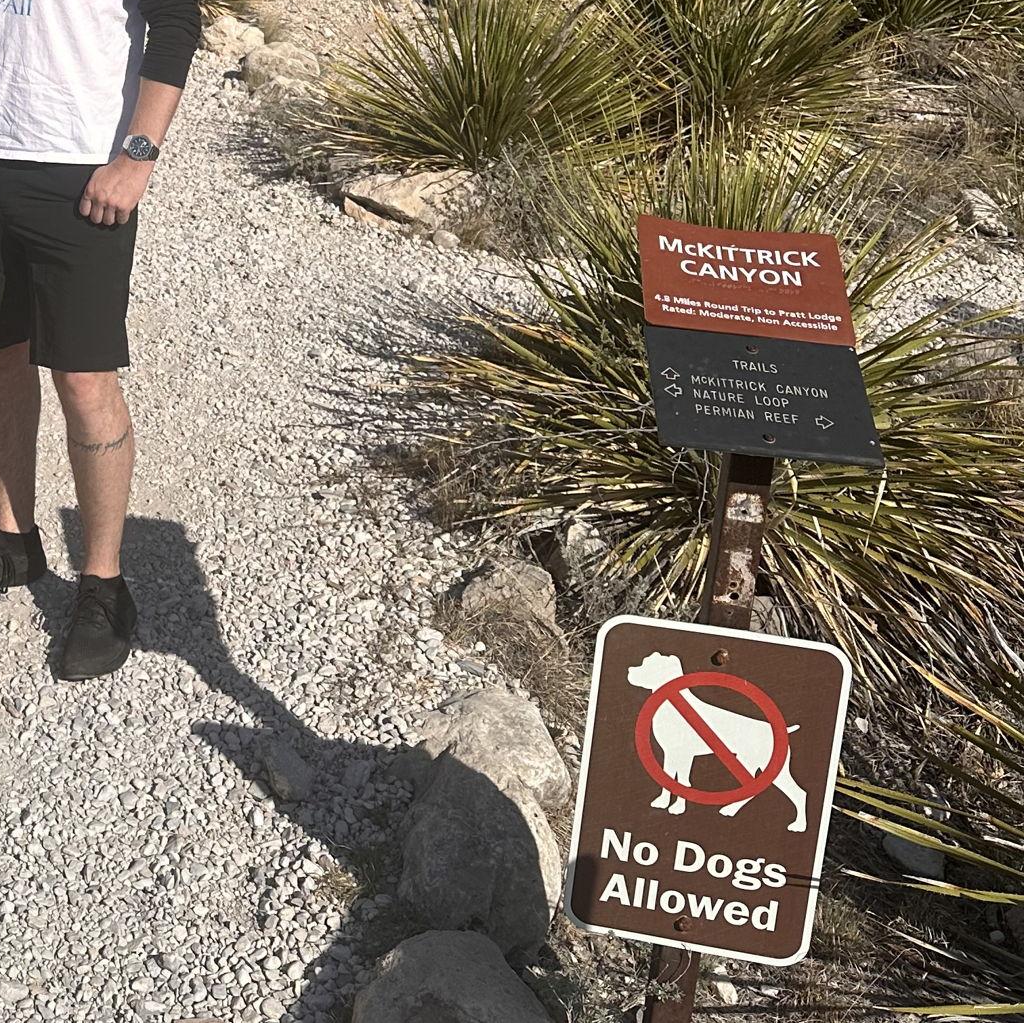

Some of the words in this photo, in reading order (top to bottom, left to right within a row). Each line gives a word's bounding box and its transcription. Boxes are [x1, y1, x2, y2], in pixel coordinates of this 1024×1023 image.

[658, 235, 821, 268] McKITTRICK
[680, 259, 802, 287] CANYON
[654, 293, 670, 302] 4.8
[673, 296, 701, 307] Miles
[704, 301, 738, 312] Round
[741, 304, 761, 316] Trip
[763, 308, 775, 316] to
[778, 309, 806, 320] Pratt
[808, 312, 842, 323] Lodge
[662, 304, 696, 315] Rated:
[699, 309, 755, 323] Moderate,
[757, 315, 780, 325] Non
[783, 319, 838, 331] Accessible
[732, 359, 778, 374] TRAILS
[691, 375, 767, 392] McKITTRICK
[776, 384, 828, 399] CANYON
[693, 388, 744, 404] NATURE
[754, 395, 789, 408] LOOP
[695, 403, 755, 420] PERMIAN
[764, 411, 799, 425] REEF
[600, 828, 659, 866] No
[673, 840, 788, 891] Dogs
[599, 873, 779, 932] Allowed
